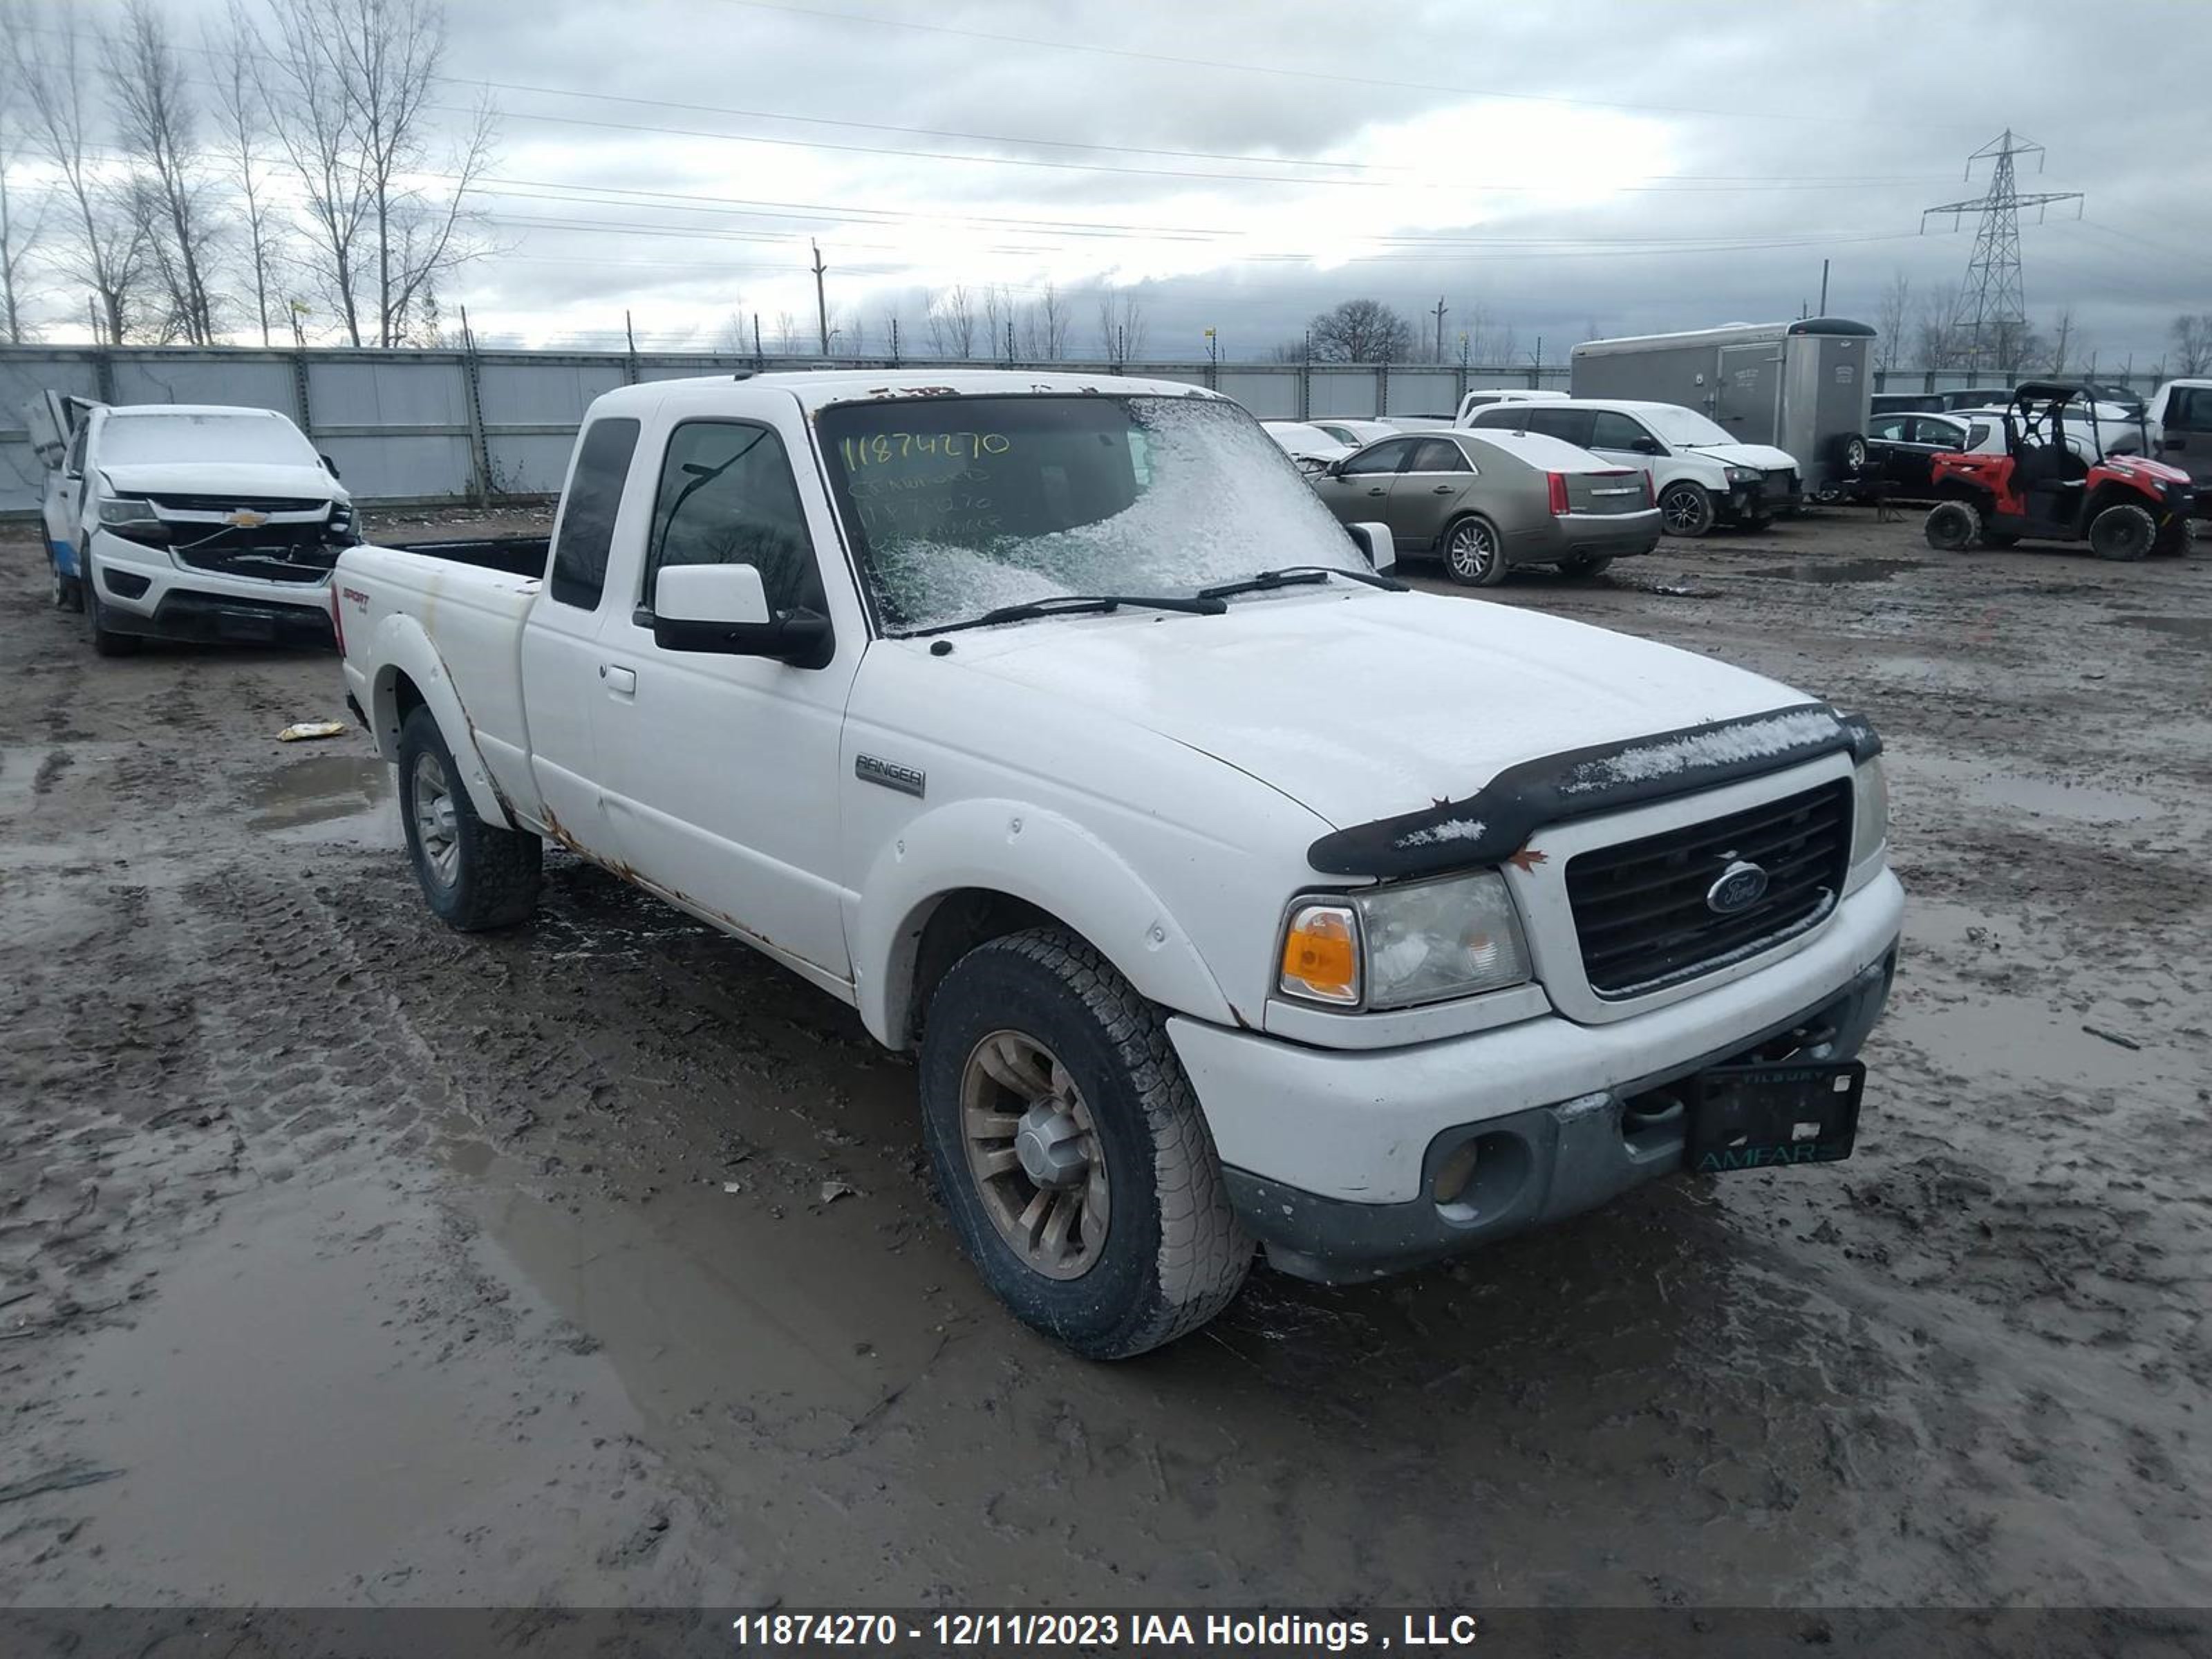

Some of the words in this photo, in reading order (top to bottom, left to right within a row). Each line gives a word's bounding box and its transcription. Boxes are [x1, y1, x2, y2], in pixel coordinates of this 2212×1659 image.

[846, 433, 1010, 471] 11874270
[344, 586, 370, 604] SPORT
[856, 755, 922, 787] RANGER
